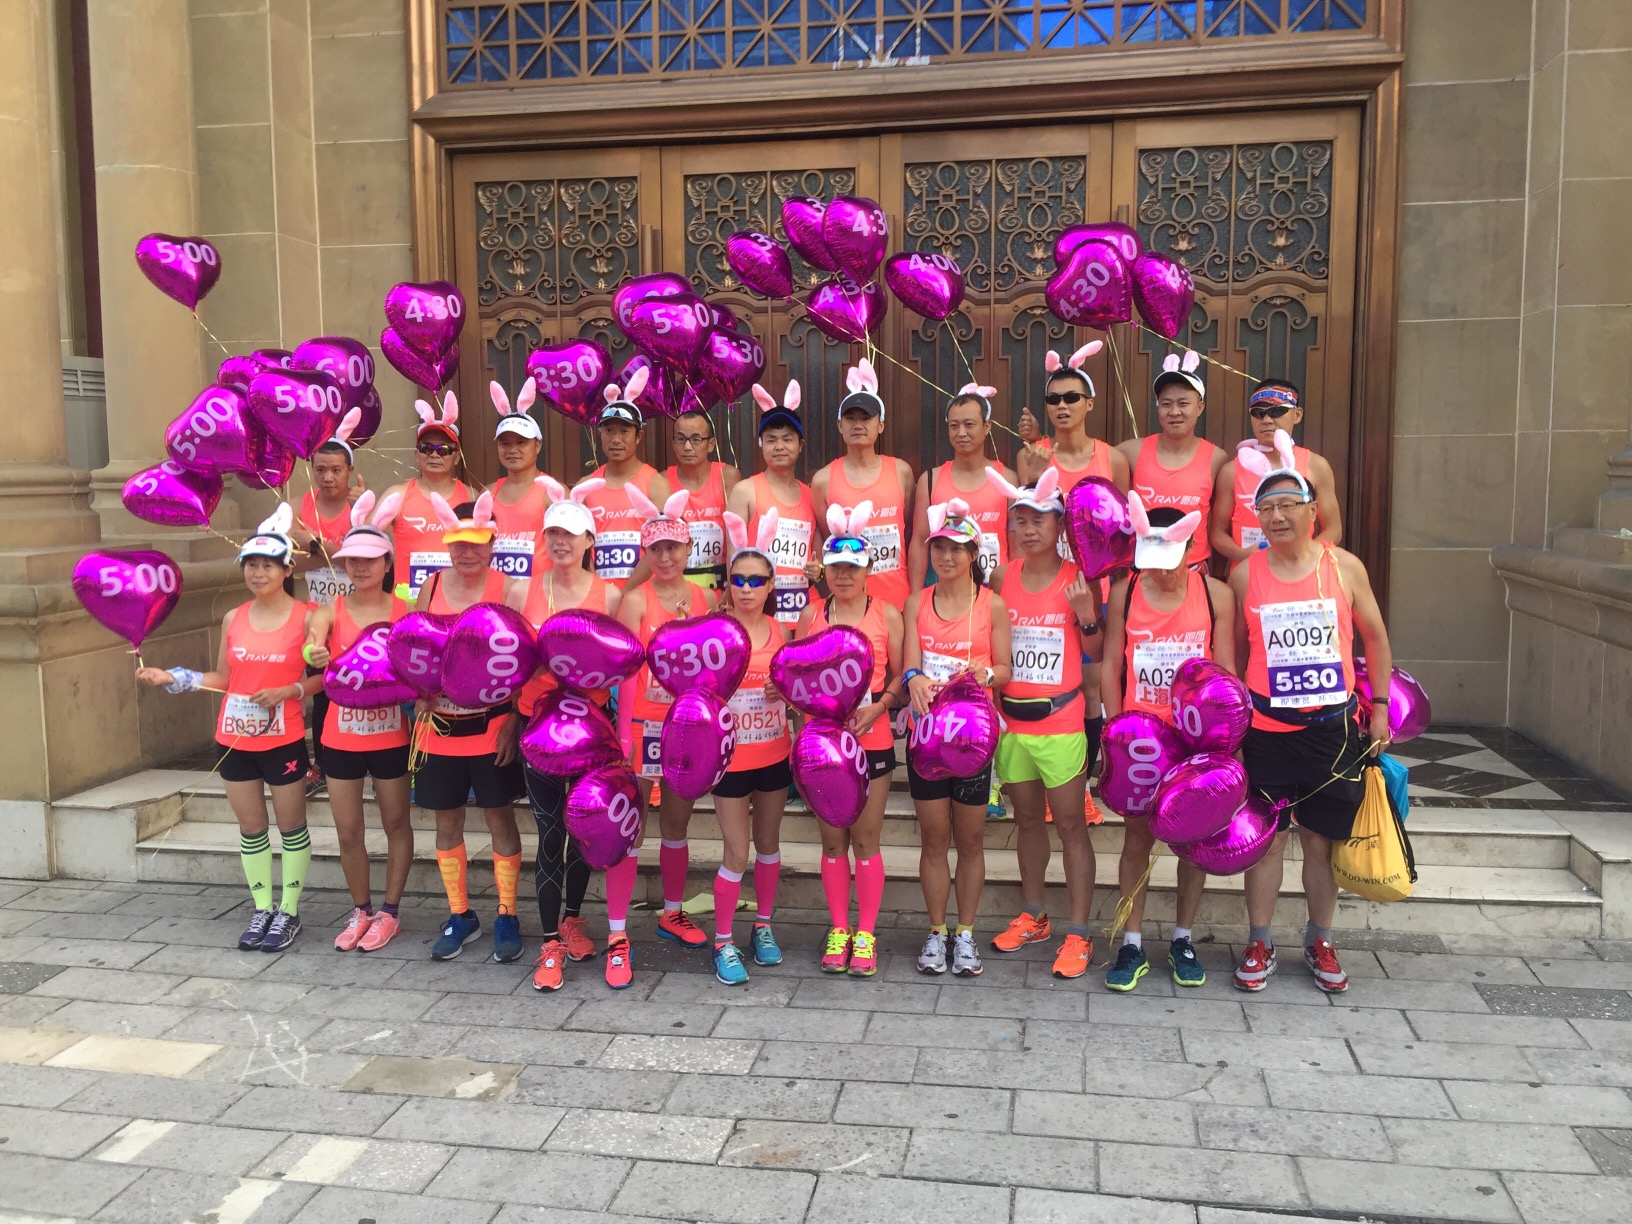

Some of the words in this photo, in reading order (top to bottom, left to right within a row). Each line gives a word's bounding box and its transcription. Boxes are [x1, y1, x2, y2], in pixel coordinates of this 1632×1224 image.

[156, 241, 216, 266] 5:00
[909, 253, 960, 275] 4:00
[1059, 262, 1110, 322] 4:30
[404, 294, 461, 323] 4:30
[652, 303, 710, 334] 5:30
[713, 336, 764, 368] 5:30
[533, 355, 597, 394] 3:30
[274, 384, 342, 414] 5:00
[172, 397, 234, 461] 5:00
[135, 458, 187, 495] 5:0
[596, 548, 636, 566] 3:30
[767, 538, 807, 558] 0410
[99, 563, 176, 597] 5:00
[490, 557, 528, 573] 4:30
[1267, 626, 1335, 650] A0097
[479, 631, 520, 704] 6:00
[654, 638, 726, 680] 5:30
[791, 658, 862, 705] 4:00
[1139, 667, 1175, 687] A03
[1275, 668, 1338, 692] 5:30
